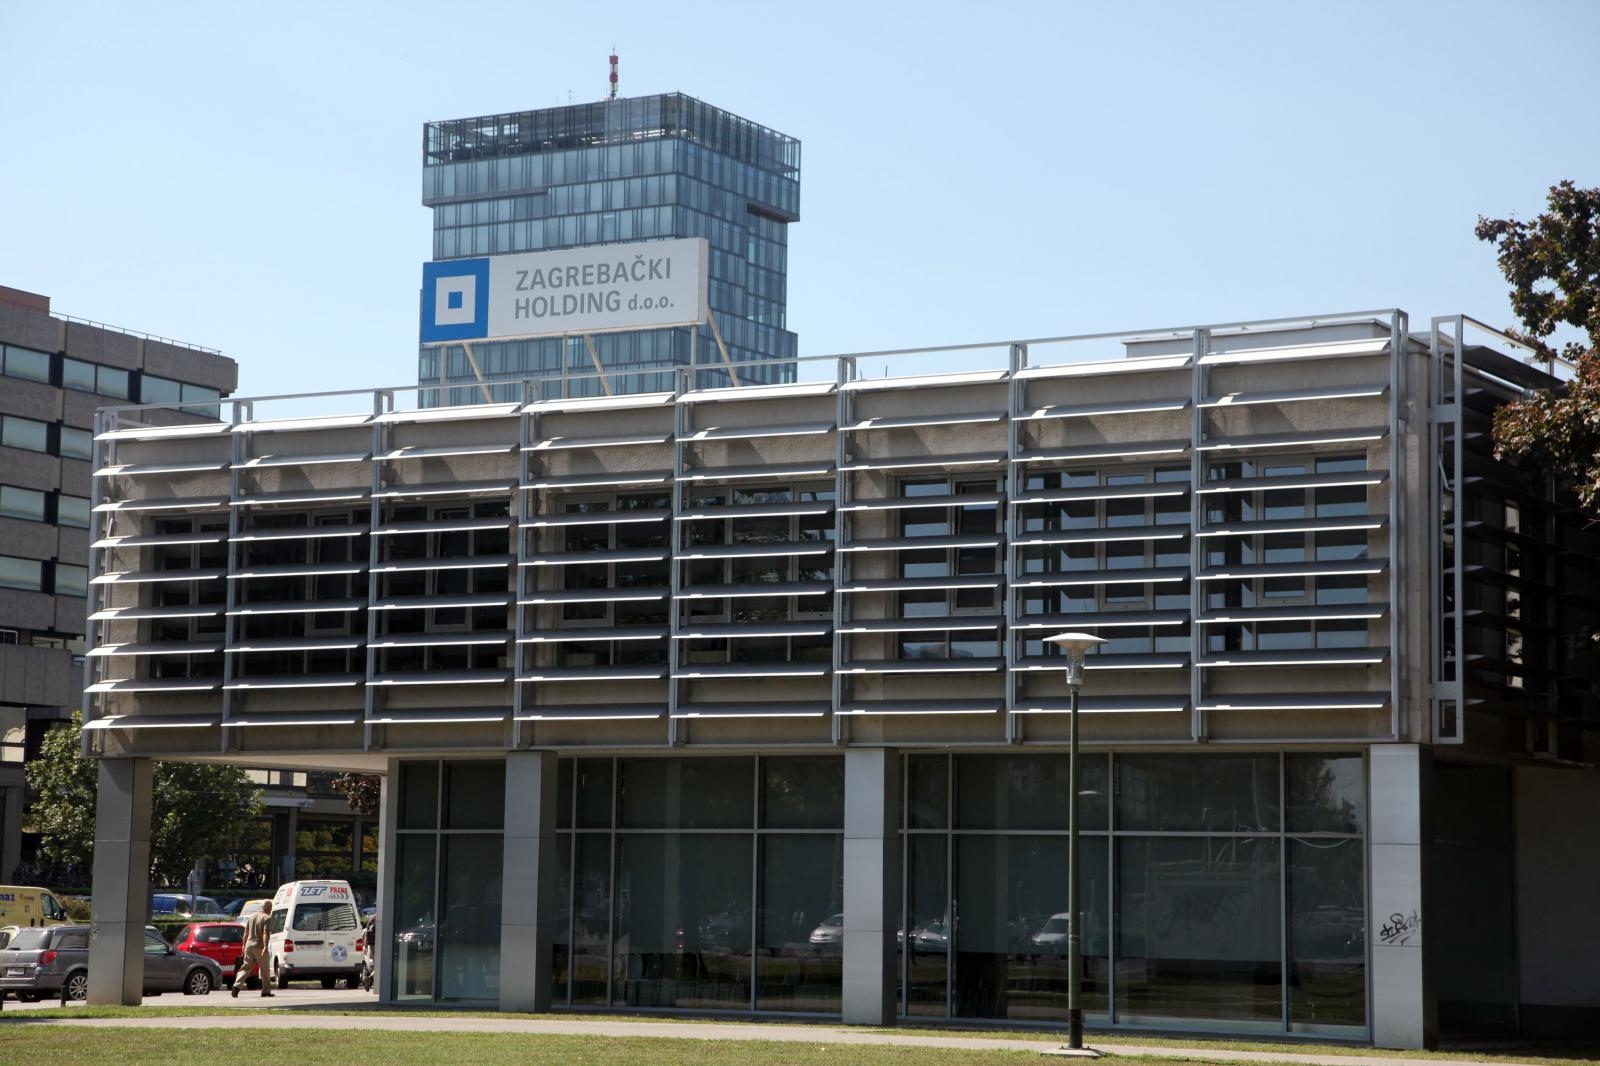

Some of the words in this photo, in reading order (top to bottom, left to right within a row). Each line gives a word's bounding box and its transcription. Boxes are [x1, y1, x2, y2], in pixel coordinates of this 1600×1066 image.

[515, 254, 671, 292] ZAGREBAČKI
[514, 290, 621, 319] HOLDING
[627, 293, 675, 312] d.o.o.
[301, 886, 328, 896] ZET
